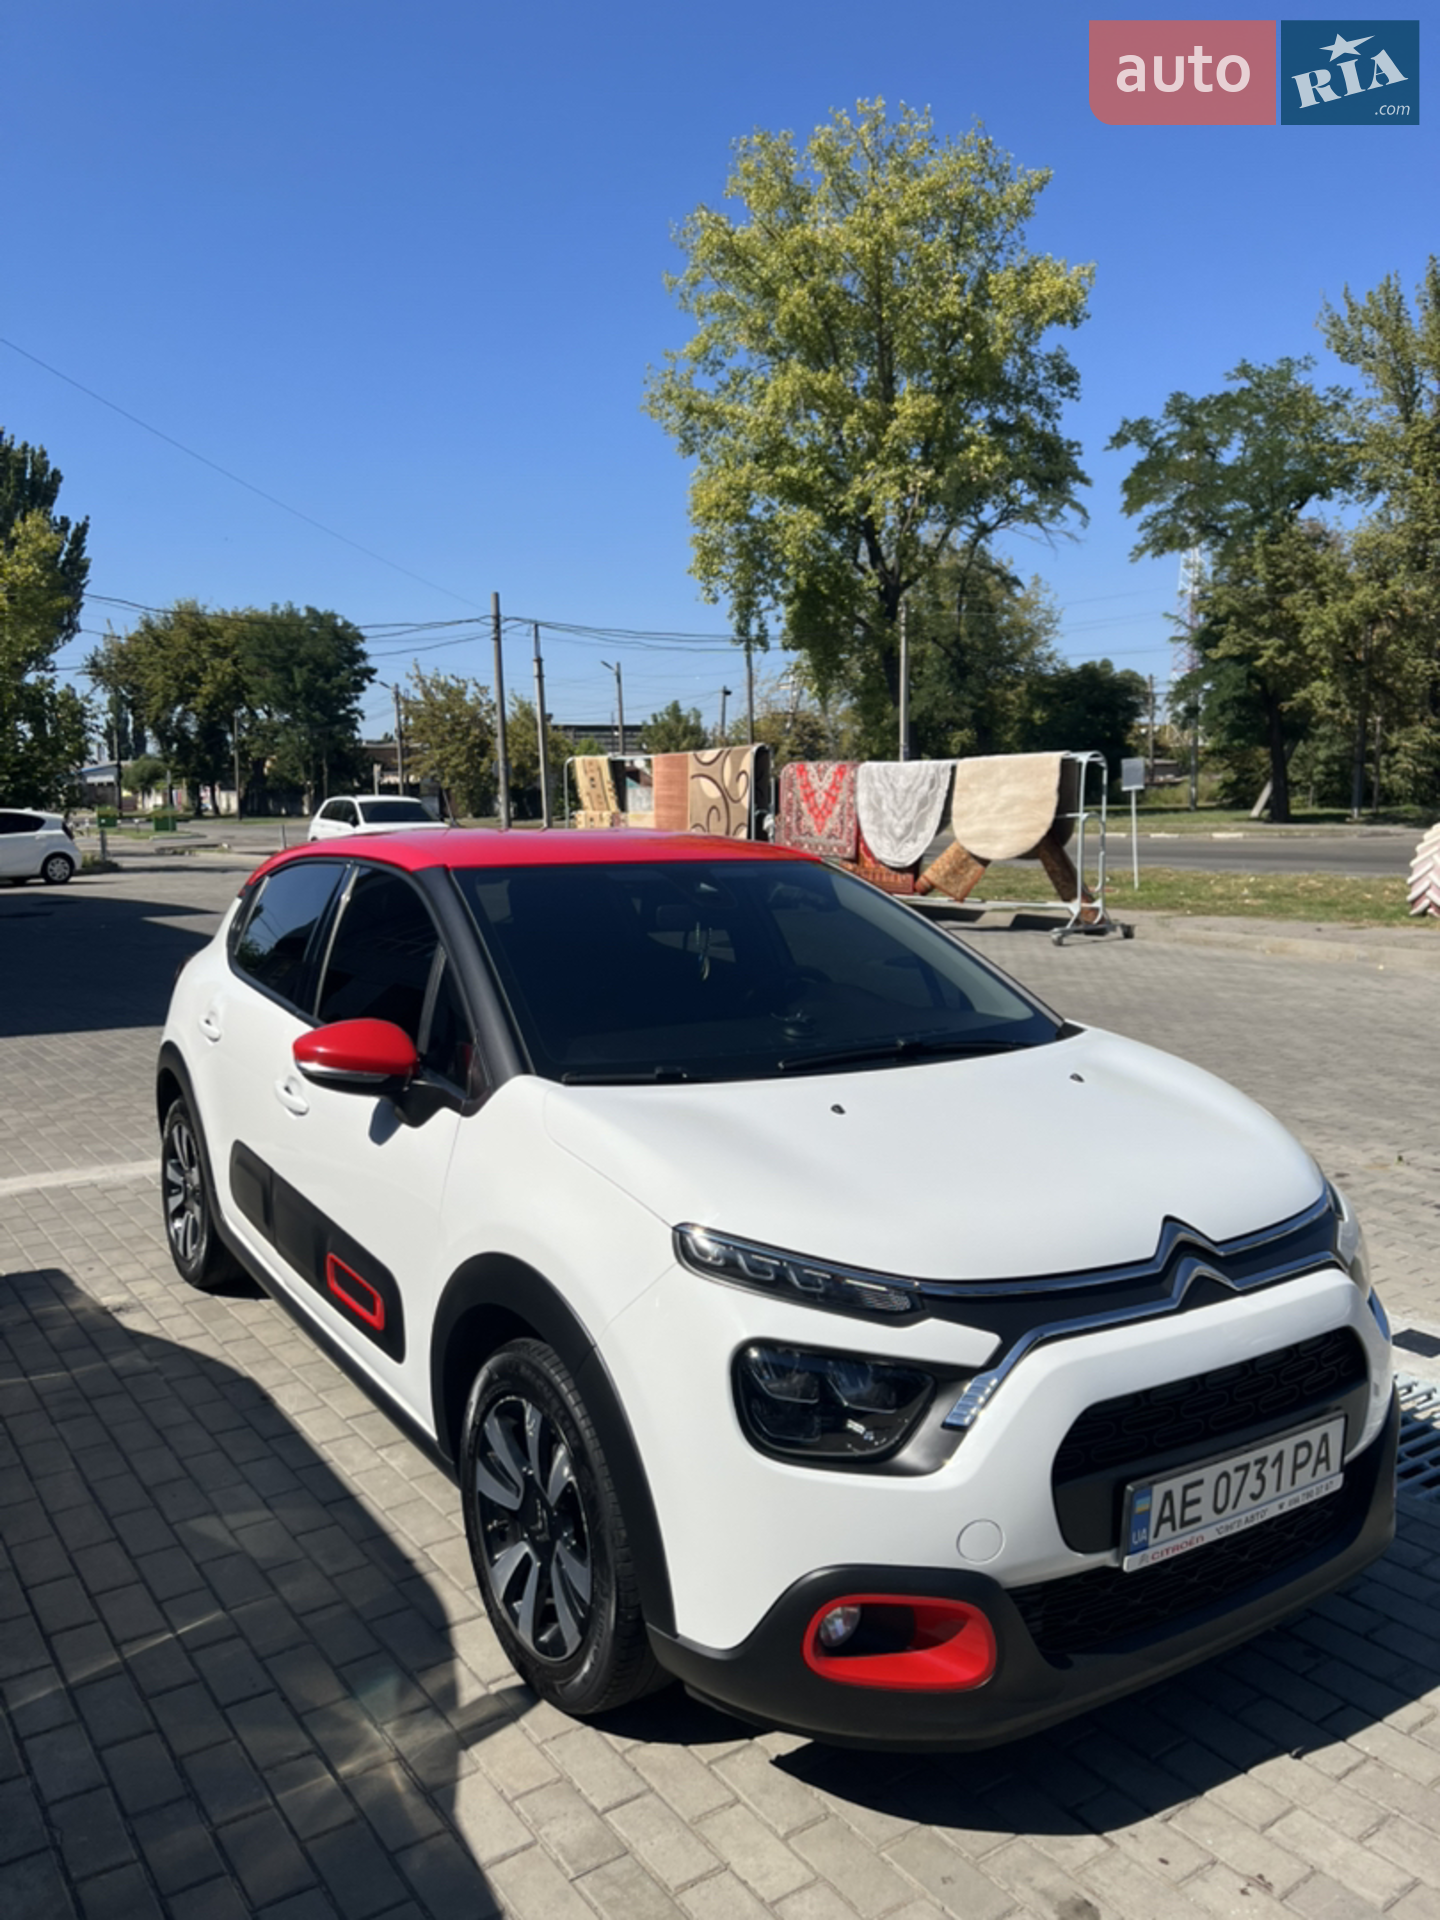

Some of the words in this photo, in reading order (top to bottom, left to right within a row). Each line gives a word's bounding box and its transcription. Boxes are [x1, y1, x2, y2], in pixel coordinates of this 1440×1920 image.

[1153, 1478, 1205, 1539] AE
[1212, 1450, 1285, 1515] 0731
[1290, 1431, 1331, 1487] PA
[1131, 1528, 1148, 1546] UA
